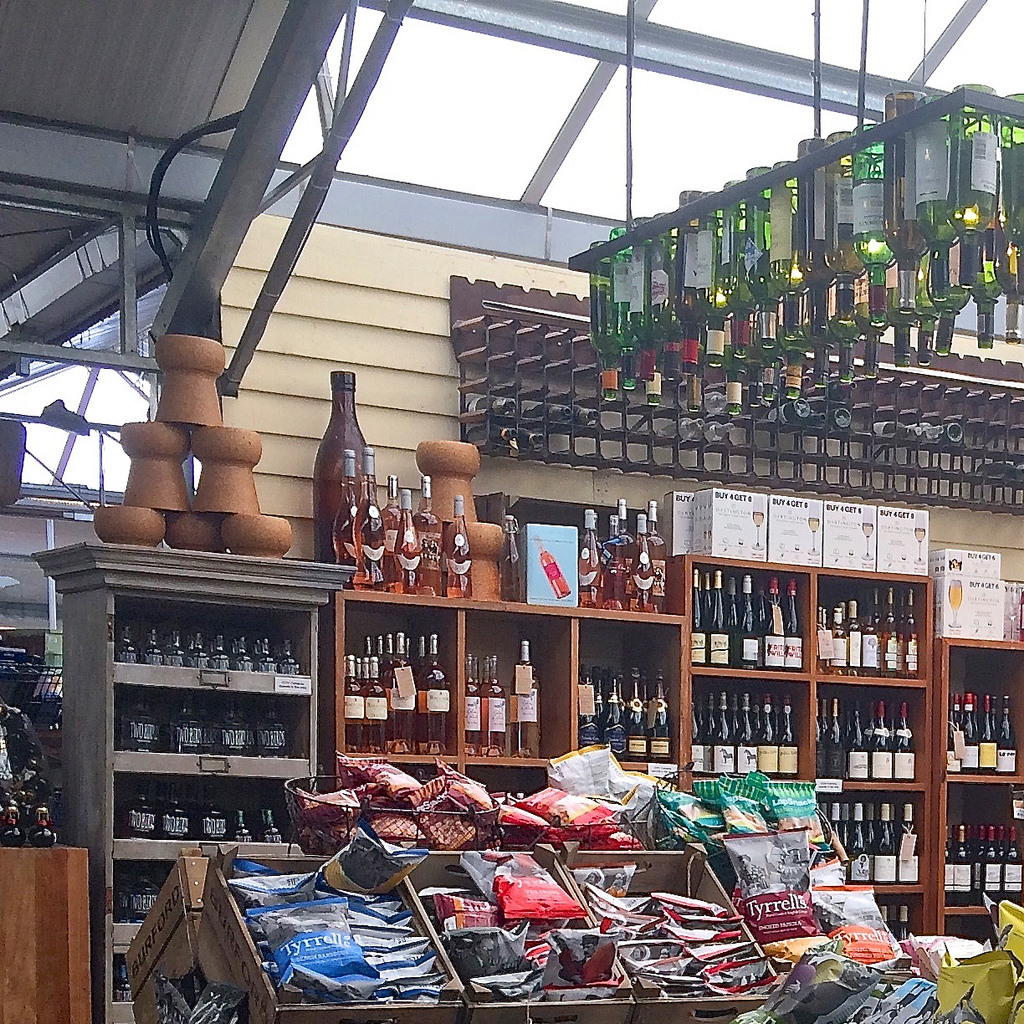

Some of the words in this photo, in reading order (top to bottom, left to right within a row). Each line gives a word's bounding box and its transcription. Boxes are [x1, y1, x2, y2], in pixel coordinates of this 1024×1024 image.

[714, 491, 729, 500] BUY
[772, 498, 786, 507] BUY
[825, 503, 840, 512] BUY
[879, 509, 893, 518] BUY
